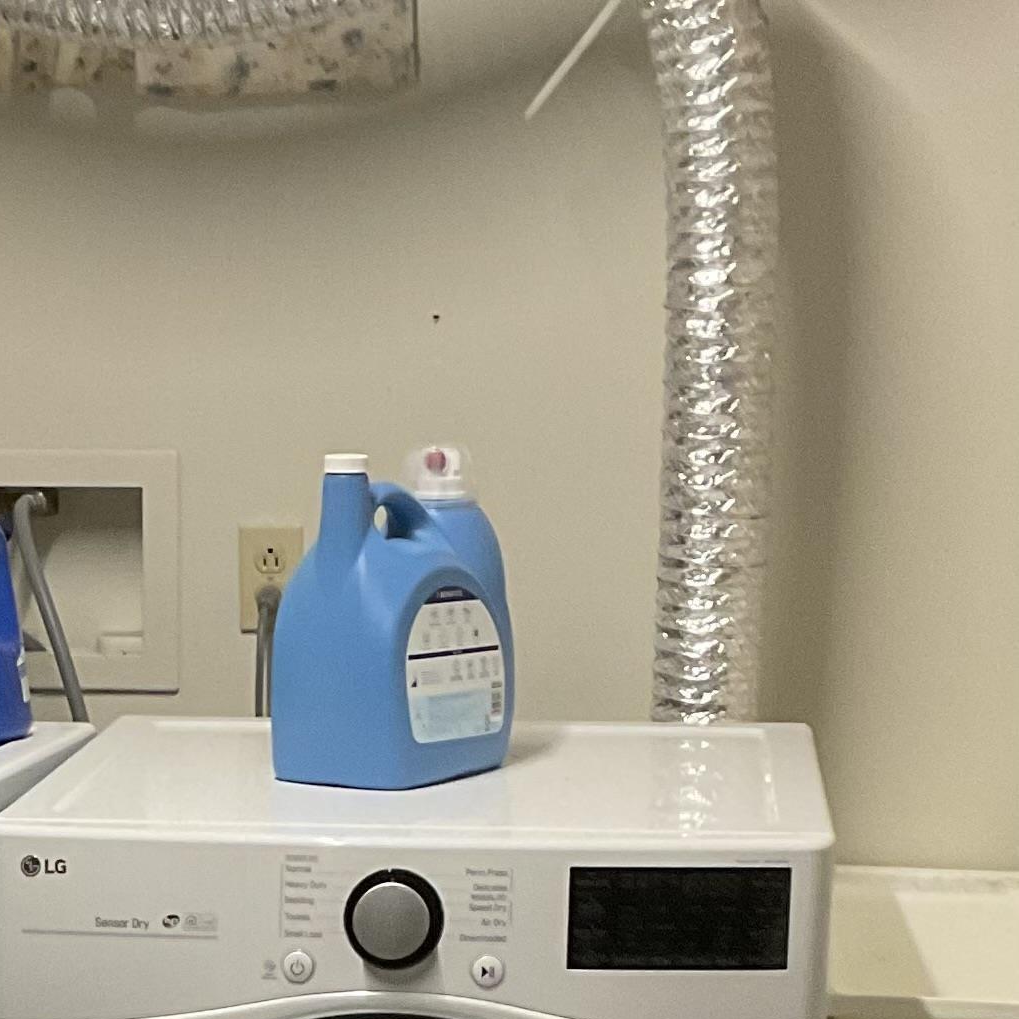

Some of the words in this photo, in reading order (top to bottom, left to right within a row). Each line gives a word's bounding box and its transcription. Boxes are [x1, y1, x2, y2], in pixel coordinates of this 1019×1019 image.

[44, 858, 67, 874] LG
[94, 916, 129, 929] Sensor
[131, 917, 150, 931] Dry
